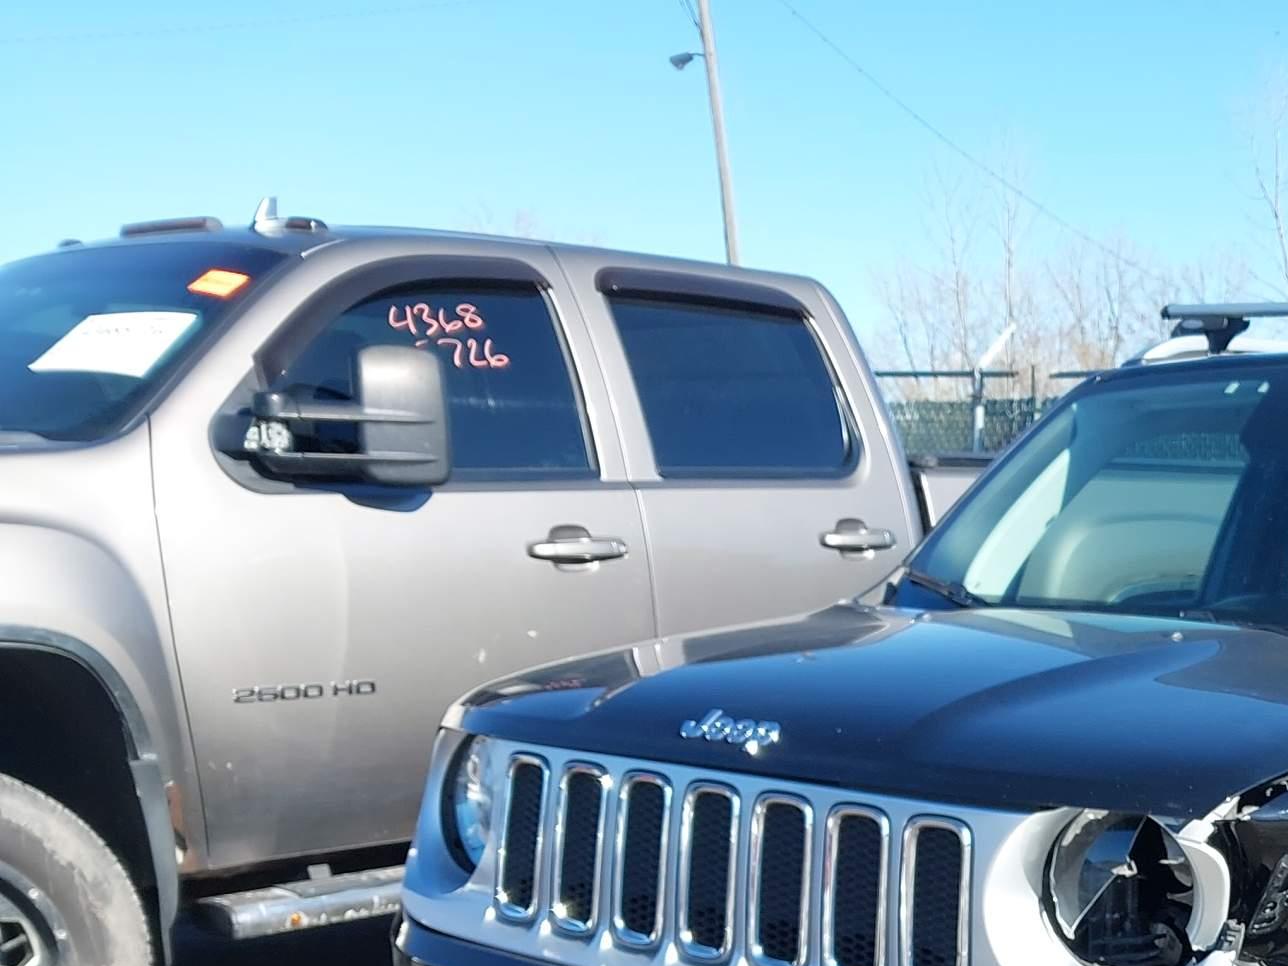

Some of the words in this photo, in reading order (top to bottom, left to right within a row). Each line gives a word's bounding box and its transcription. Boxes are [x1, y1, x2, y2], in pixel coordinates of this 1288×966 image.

[388, 302, 484, 335] 4368
[233, 684, 324, 703] 2500
[332, 679, 377, 696] HD
[680, 707, 781, 756] Jeep
